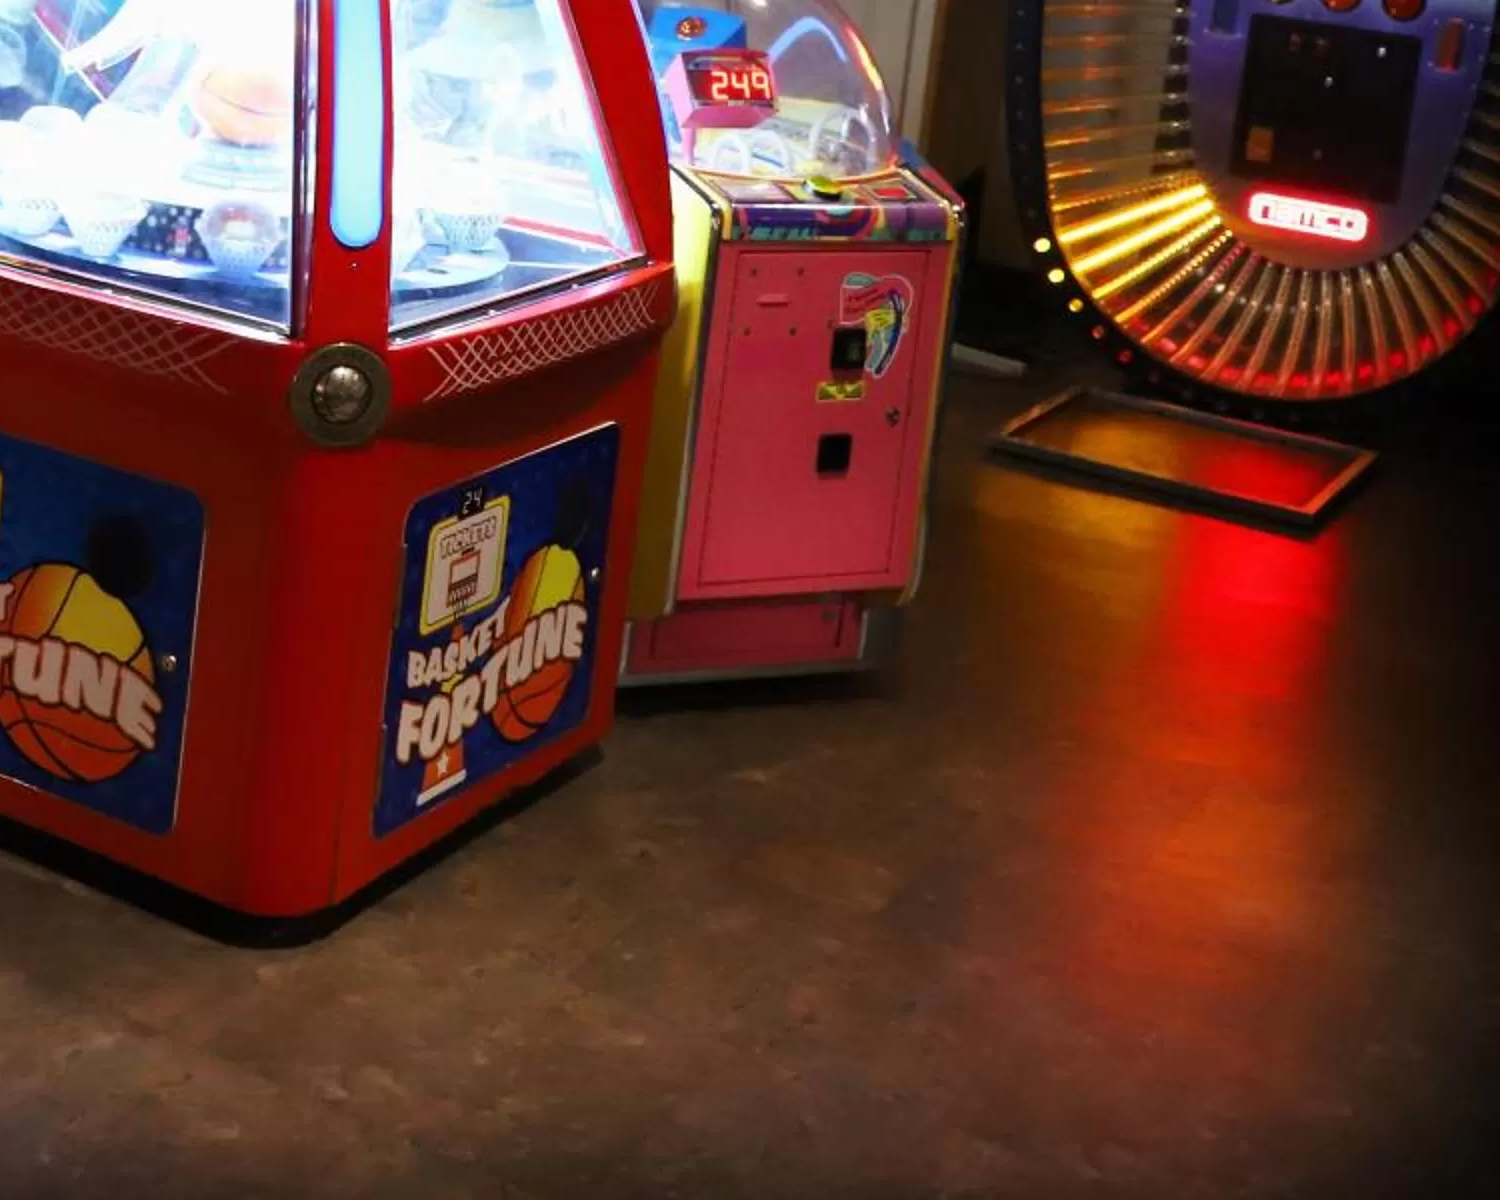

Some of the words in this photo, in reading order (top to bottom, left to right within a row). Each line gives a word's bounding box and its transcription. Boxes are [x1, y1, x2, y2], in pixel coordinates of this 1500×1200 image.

[710, 70, 771, 101] 249
[1249, 193, 1368, 241] namco
[461, 486, 483, 515] 24
[439, 515, 497, 559] TICKETS
[407, 596, 510, 689] BASKET
[395, 601, 588, 763] FORTUNE
